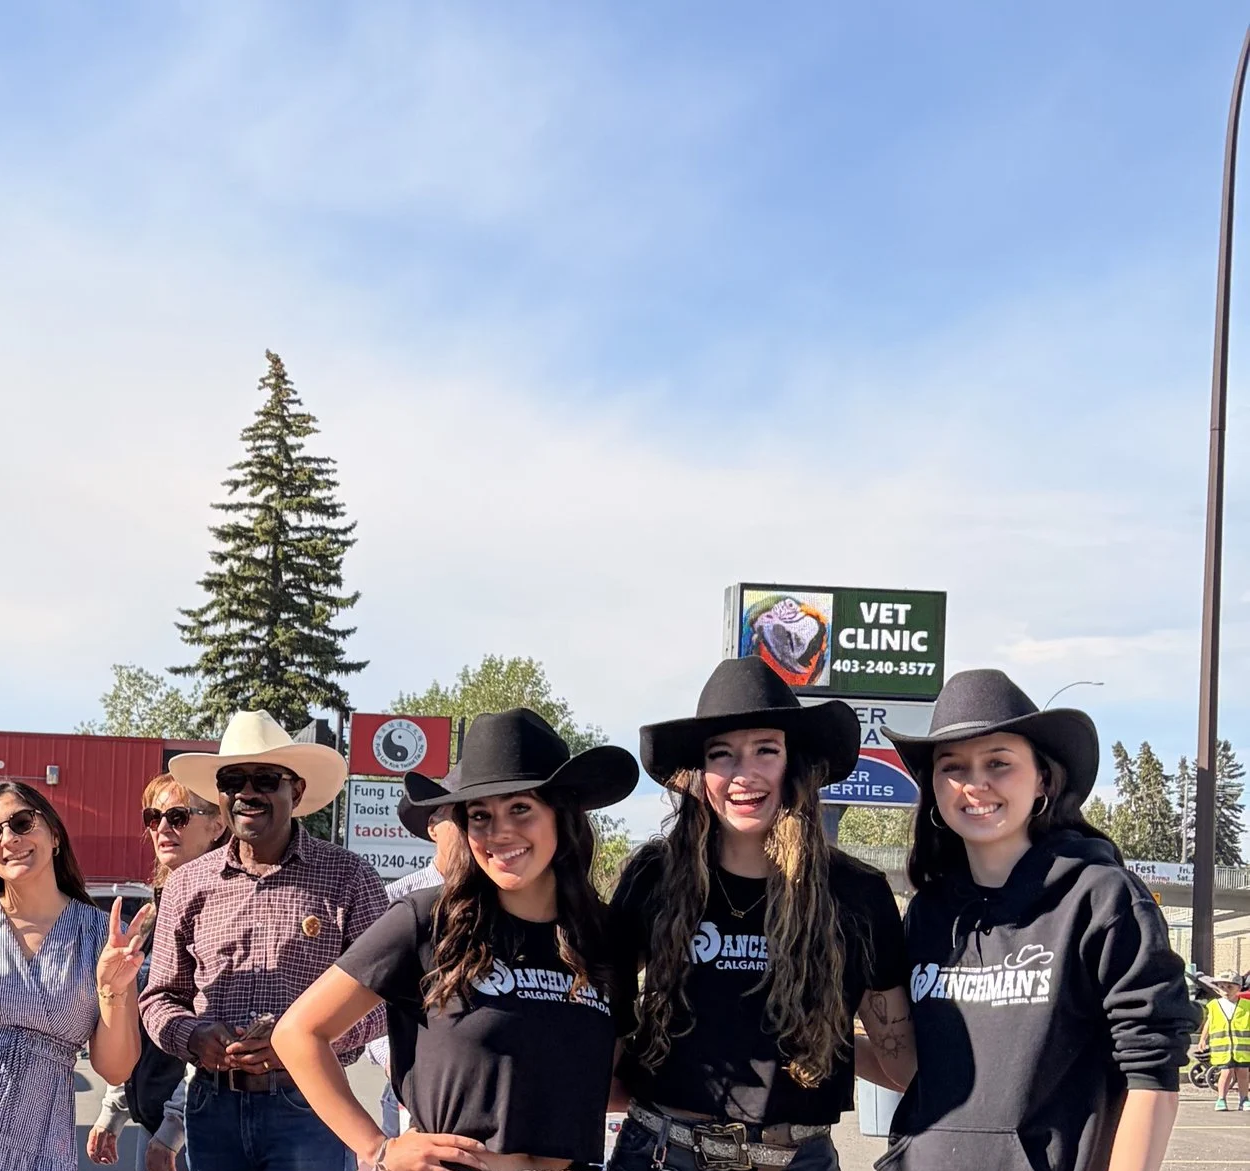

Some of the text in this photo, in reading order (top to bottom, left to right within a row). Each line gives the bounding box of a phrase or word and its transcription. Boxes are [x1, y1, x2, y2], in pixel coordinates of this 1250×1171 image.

[859, 602, 912, 625] VET
[838, 628, 929, 652] CLINIC
[832, 659, 936, 676] 403-240-3577
[354, 785, 385, 800] Fung
[353, 803, 390, 816] Taoist
[354, 824, 417, 838] taoist.
[516, 990, 567, 1003] CALGARY,
